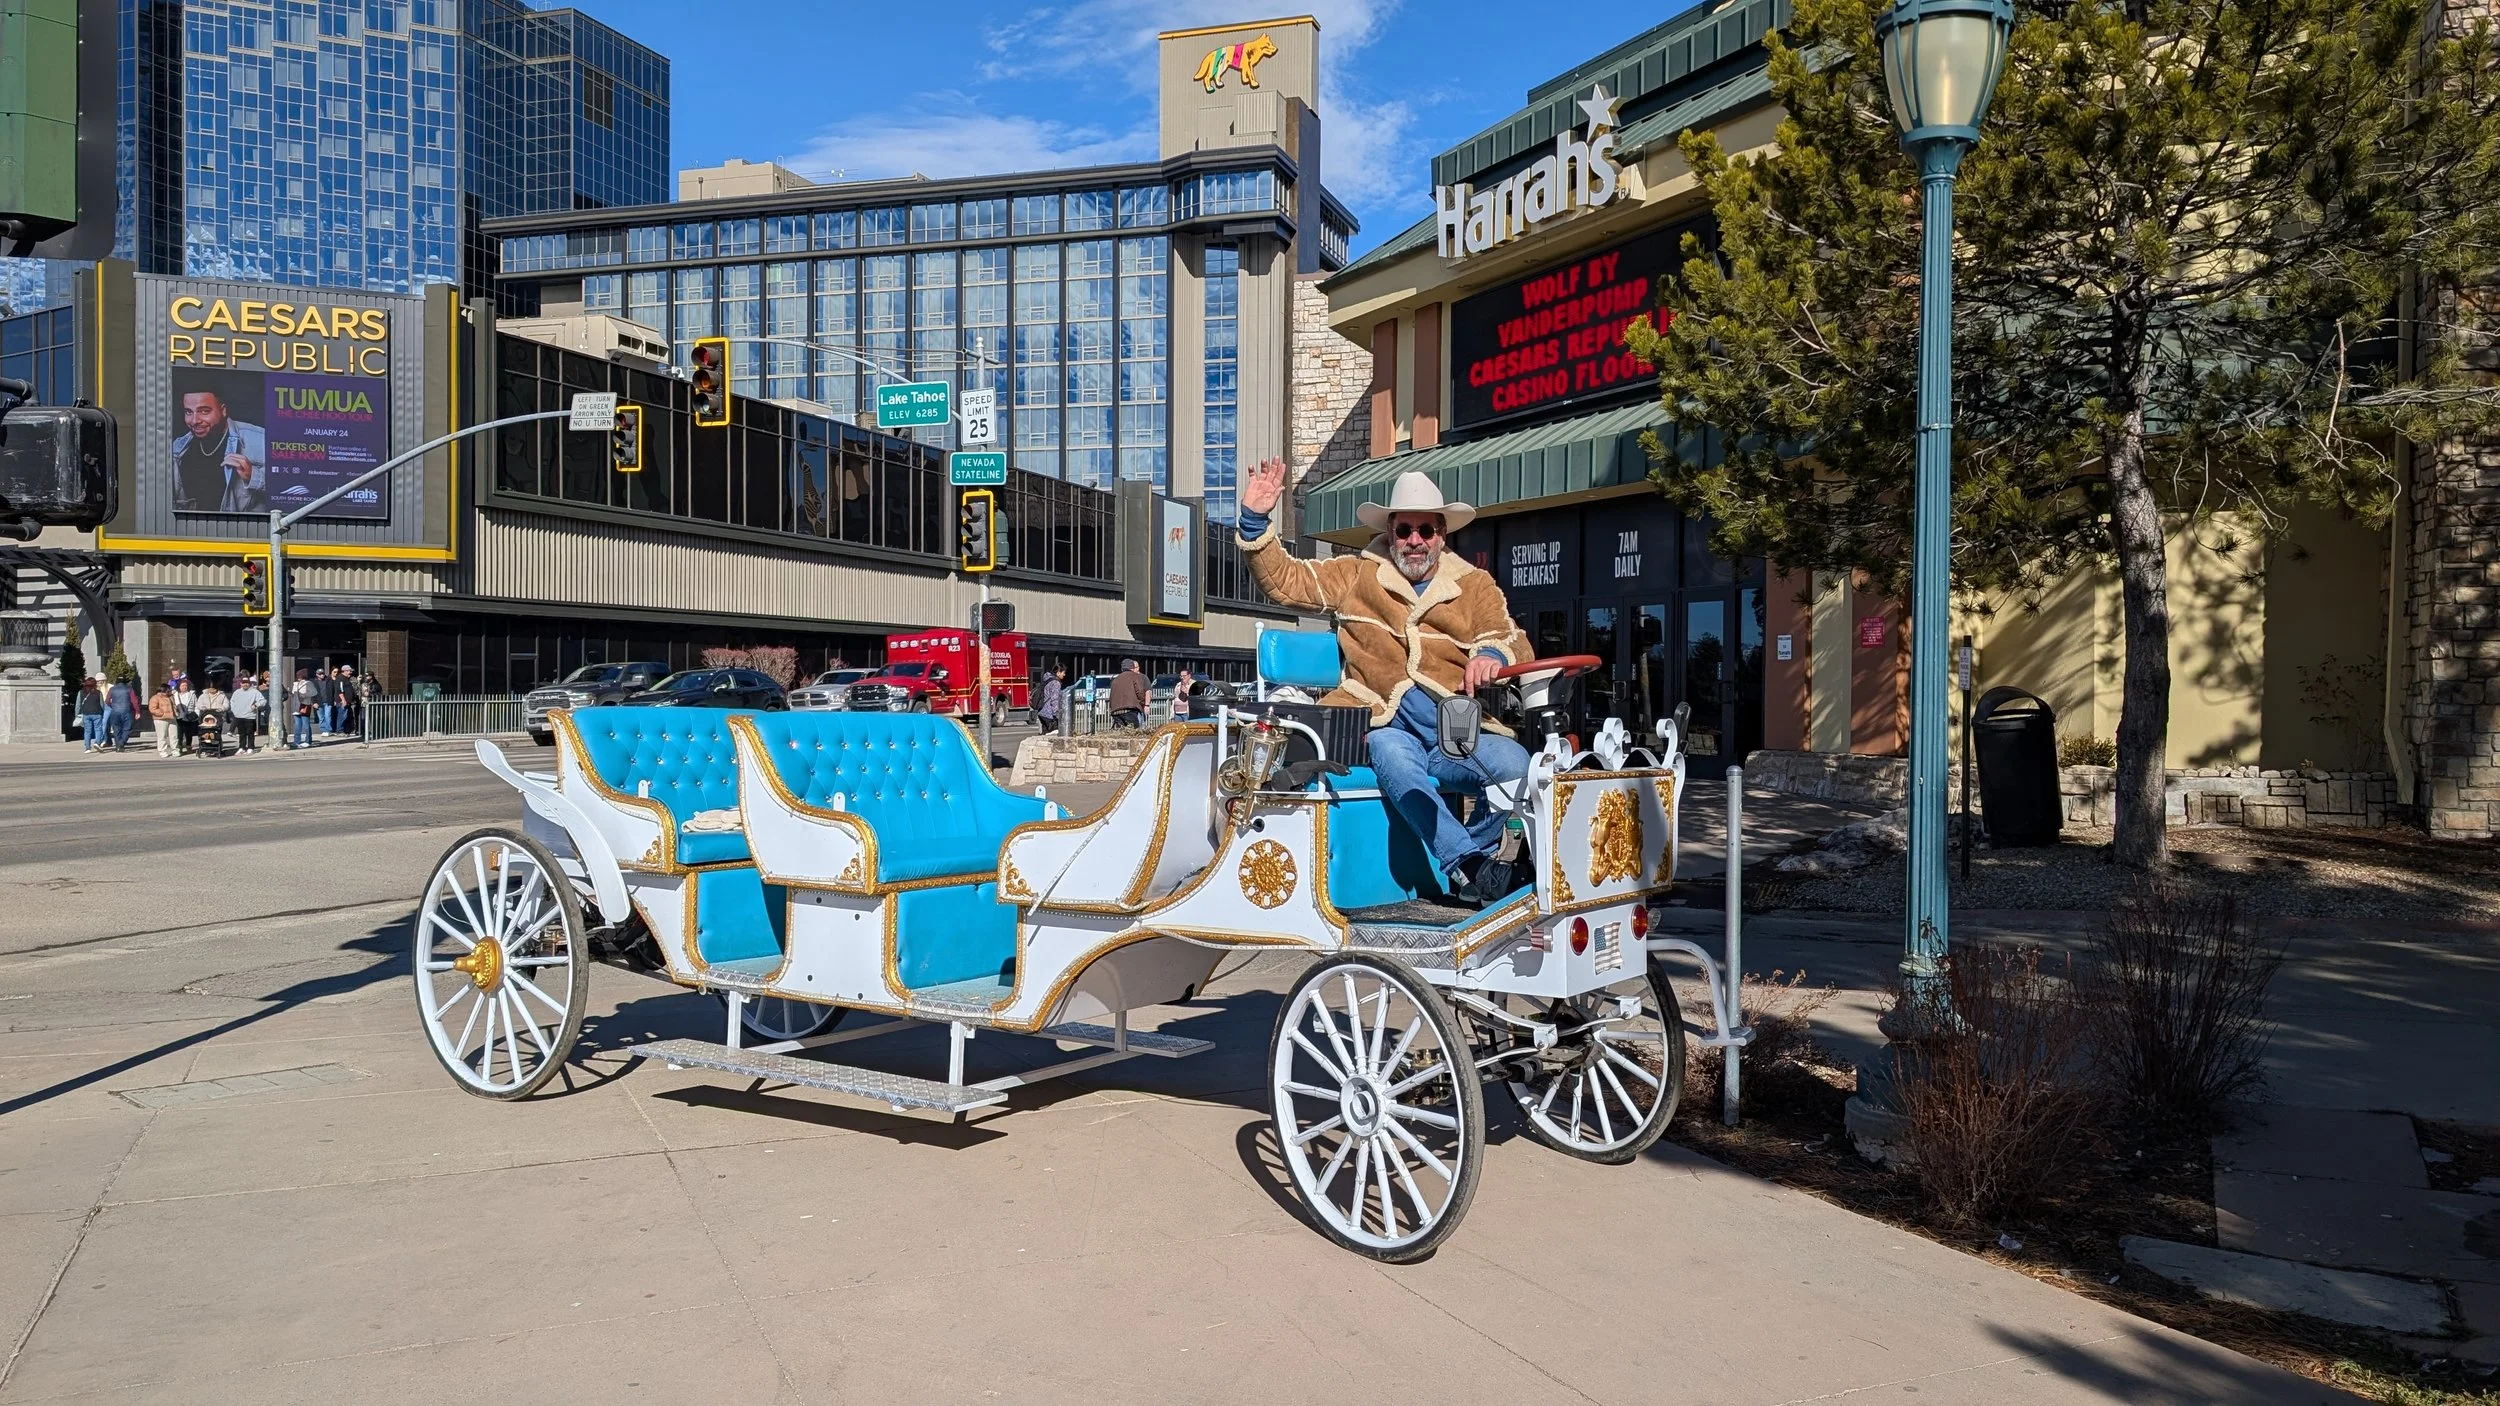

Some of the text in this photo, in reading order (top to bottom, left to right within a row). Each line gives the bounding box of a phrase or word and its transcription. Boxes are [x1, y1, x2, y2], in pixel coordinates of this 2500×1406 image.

[1521, 251, 1620, 309] WOLF BY
[170, 297, 386, 341] CAESARS
[1497, 277, 1648, 347] VANDERPUMP
[170, 334, 386, 375] REPUBLIC
[1469, 338, 1560, 388] CAESARS
[274, 387, 373, 413] TUMUA
[880, 391, 946, 405] Lake Tahoe
[1492, 368, 1569, 412] CASINO
[963, 395, 993, 406] SPEED
[889, 408, 938, 420] ELEV 6285
[967, 406, 990, 417] LIMIT
[304, 428, 337, 436] JANUARY
[969, 418, 989, 438] 25
[270, 442, 325, 452] TICKETS ON
[271, 451, 326, 460] SALE NOW
[961, 458, 996, 467] NEVADA
[955, 470, 1001, 479] STATELINE
[1618, 530, 1639, 554] 7AM
[1511, 541, 1561, 566] SERVING UP
[1512, 563, 1561, 587] BREAKFAST
[1614, 554, 1642, 578] DAILY
[1165, 572, 1188, 586] CAESARS
[1165, 585, 1189, 598] REPUBLIC
